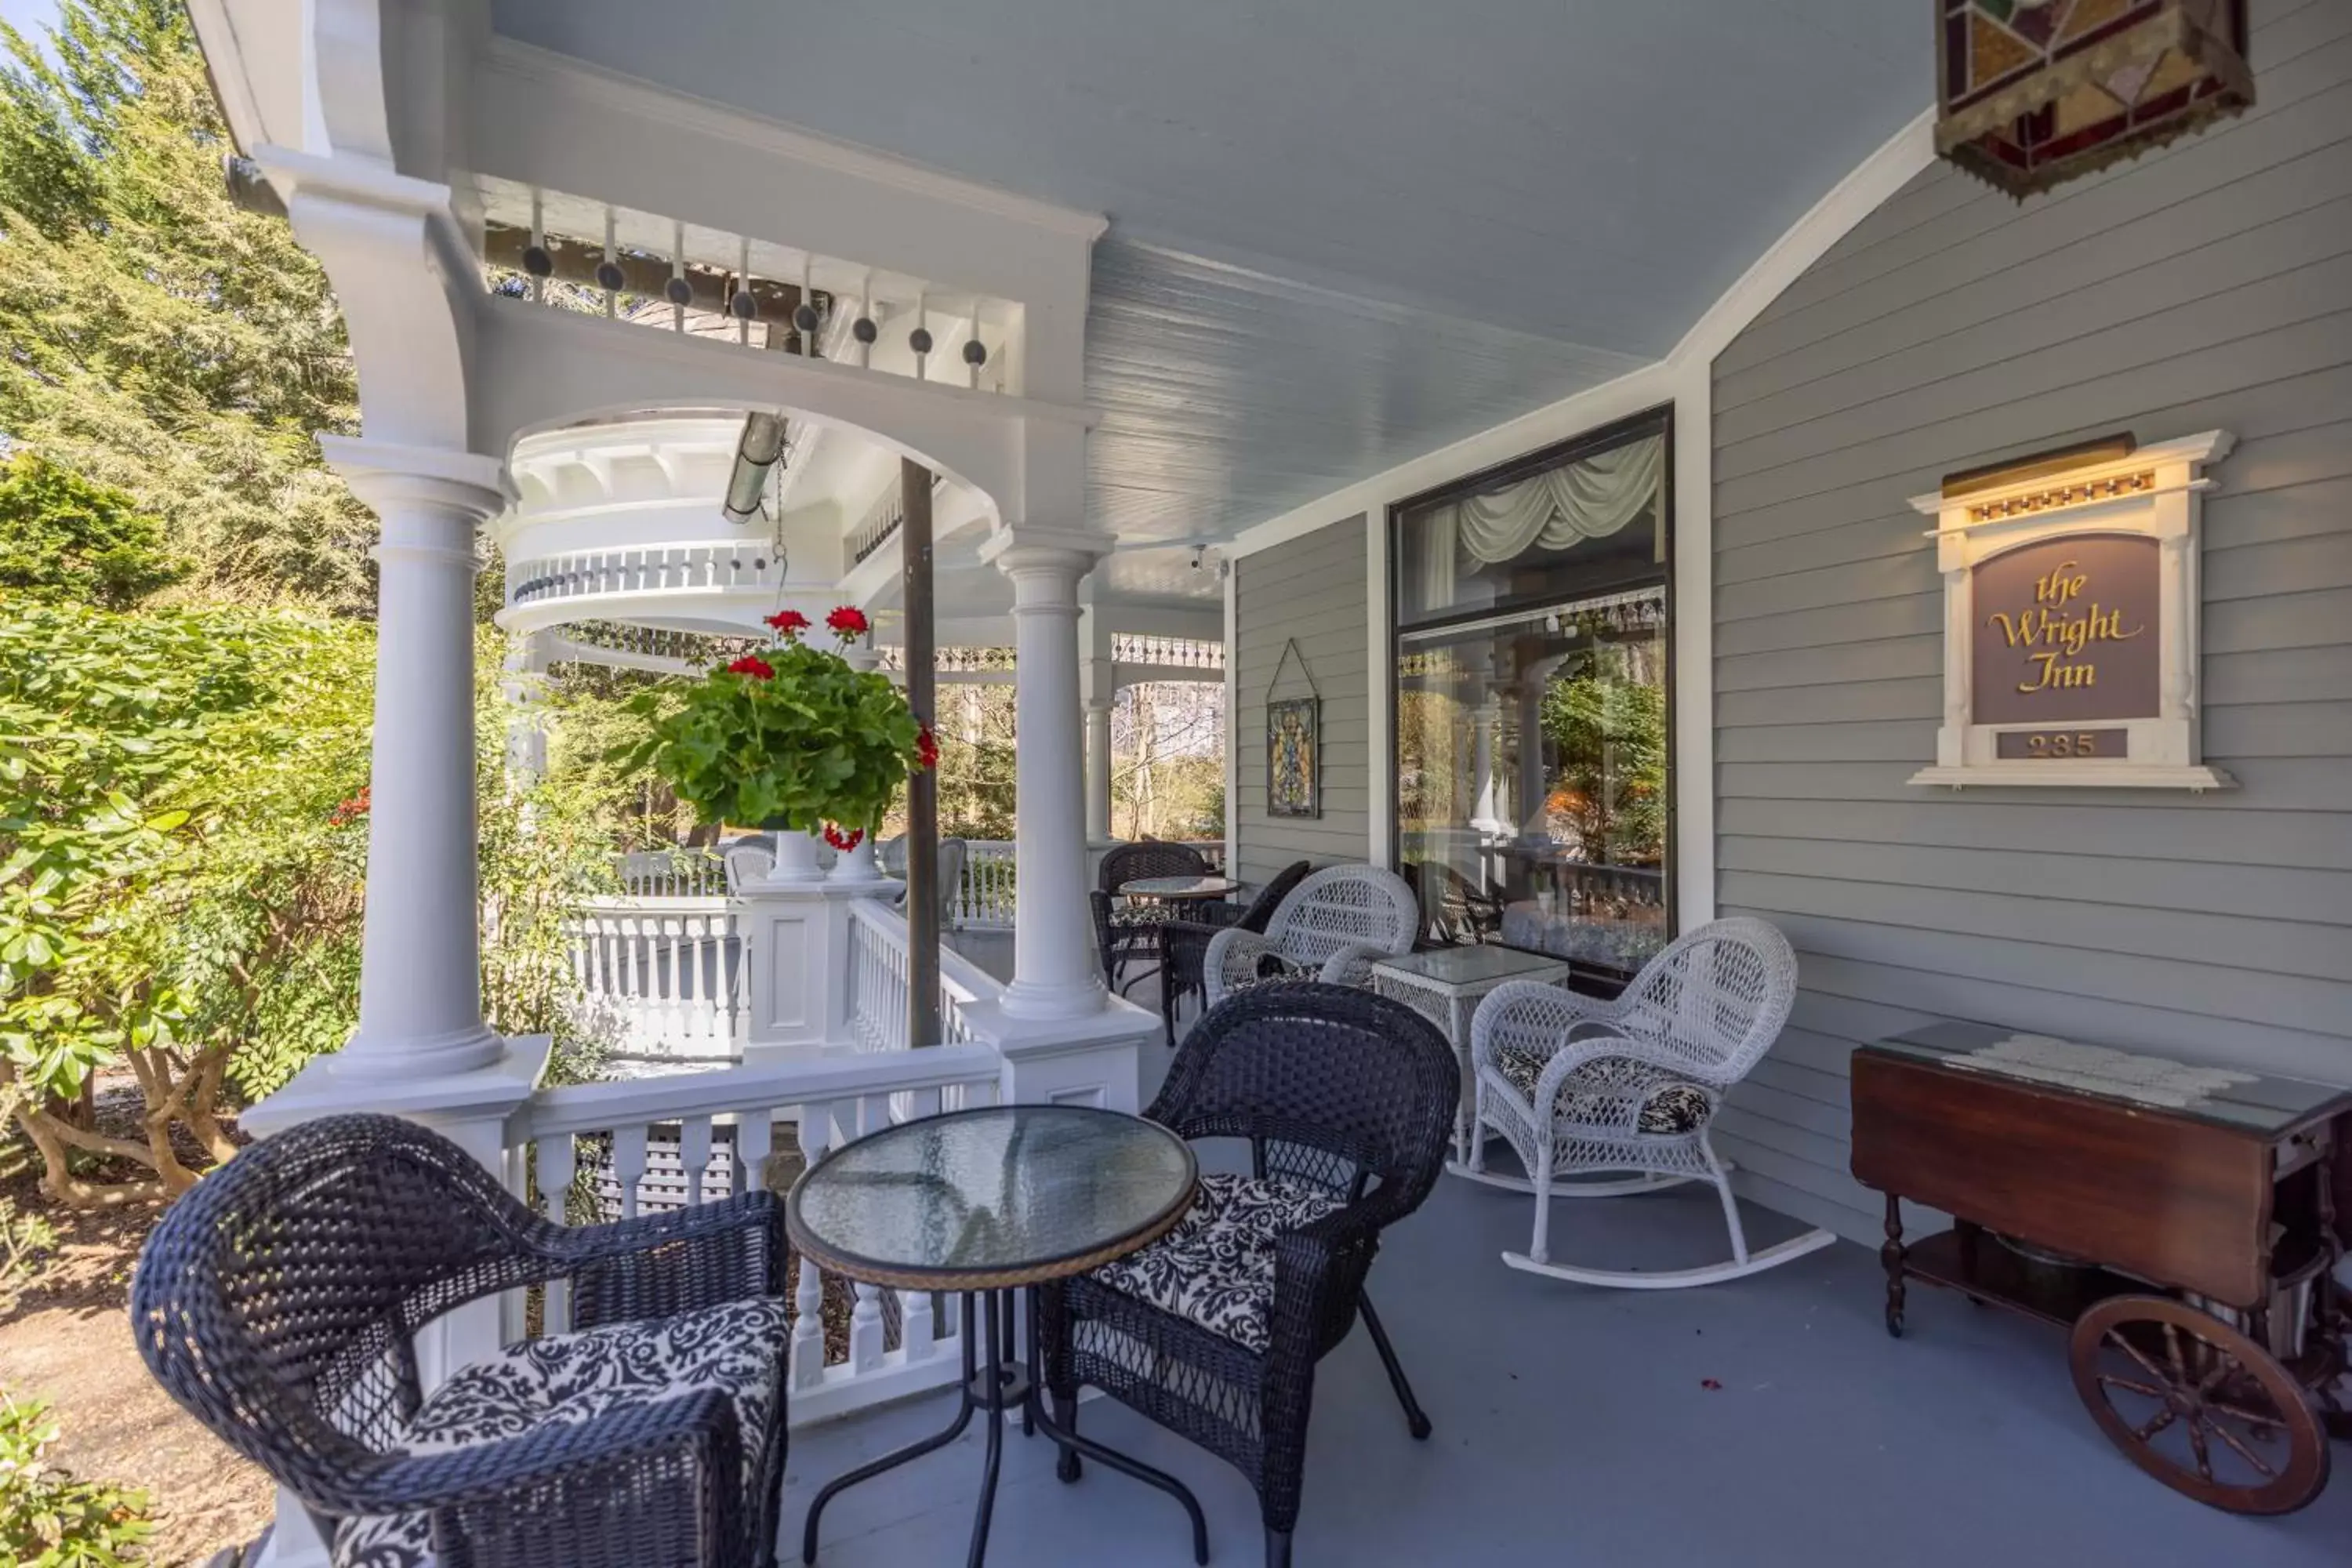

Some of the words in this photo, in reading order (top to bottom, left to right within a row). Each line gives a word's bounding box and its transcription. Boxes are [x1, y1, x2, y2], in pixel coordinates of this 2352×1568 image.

[2036, 561, 2087, 608] the
[1988, 604, 2144, 655] Wright
[2020, 652, 2095, 691] Inn
[2029, 734, 2095, 757] 235
